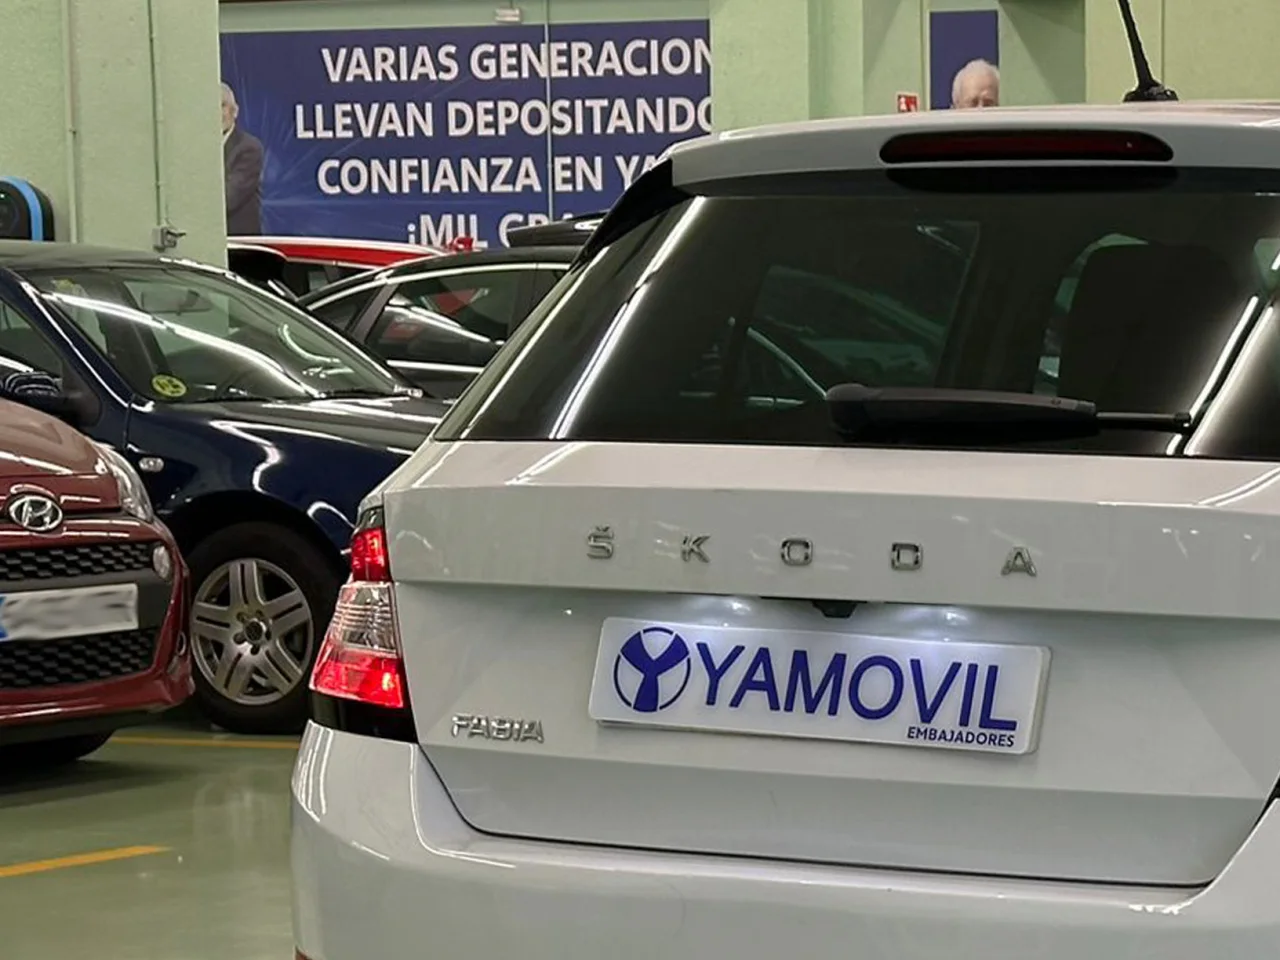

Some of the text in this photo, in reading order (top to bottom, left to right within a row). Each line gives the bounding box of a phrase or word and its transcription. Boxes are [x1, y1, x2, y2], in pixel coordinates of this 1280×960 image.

[321, 44, 459, 82] VARIAS
[295, 102, 434, 138] LLEVAN
[317, 156, 542, 195] CONFIANZA
[553, 155, 603, 191] EN
[586, 525, 1038, 578] ŠKODA
[696, 642, 1018, 732] YAMOVIL
[451, 712, 545, 744] FABIA
[906, 725, 1016, 748] EMBAJADORES
